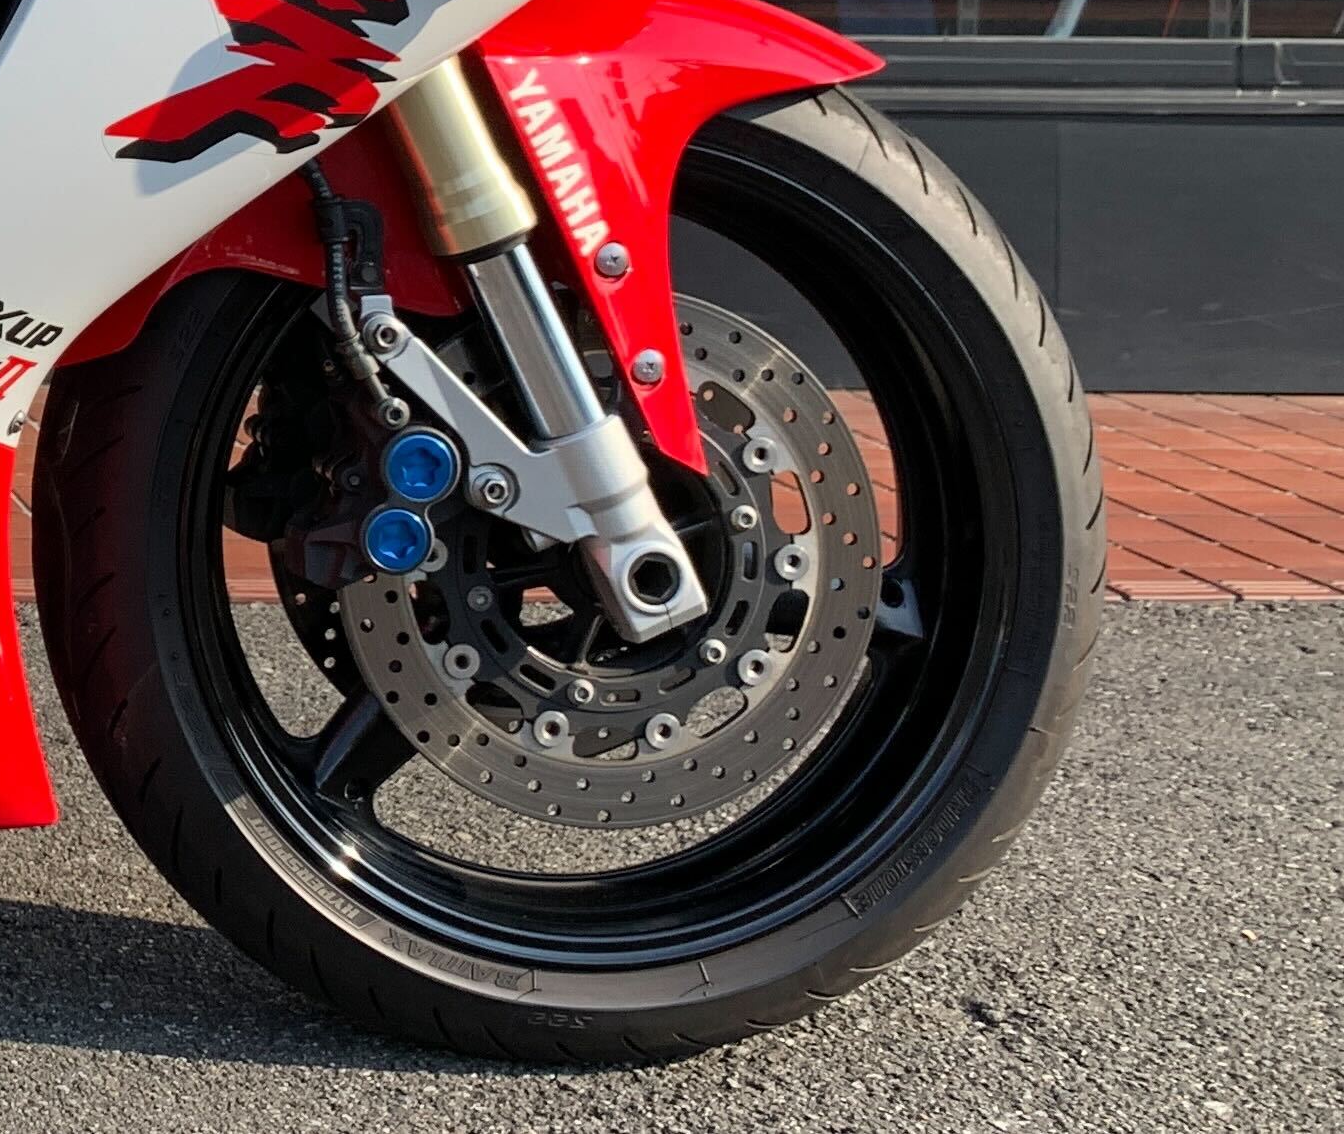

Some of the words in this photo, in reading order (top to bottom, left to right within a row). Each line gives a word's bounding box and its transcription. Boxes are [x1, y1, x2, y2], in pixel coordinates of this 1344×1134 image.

[508, 68, 611, 257] YAMAHA
[242, 817, 360, 920] HYPERSPORT
[379, 927, 522, 991] BATTLAX
